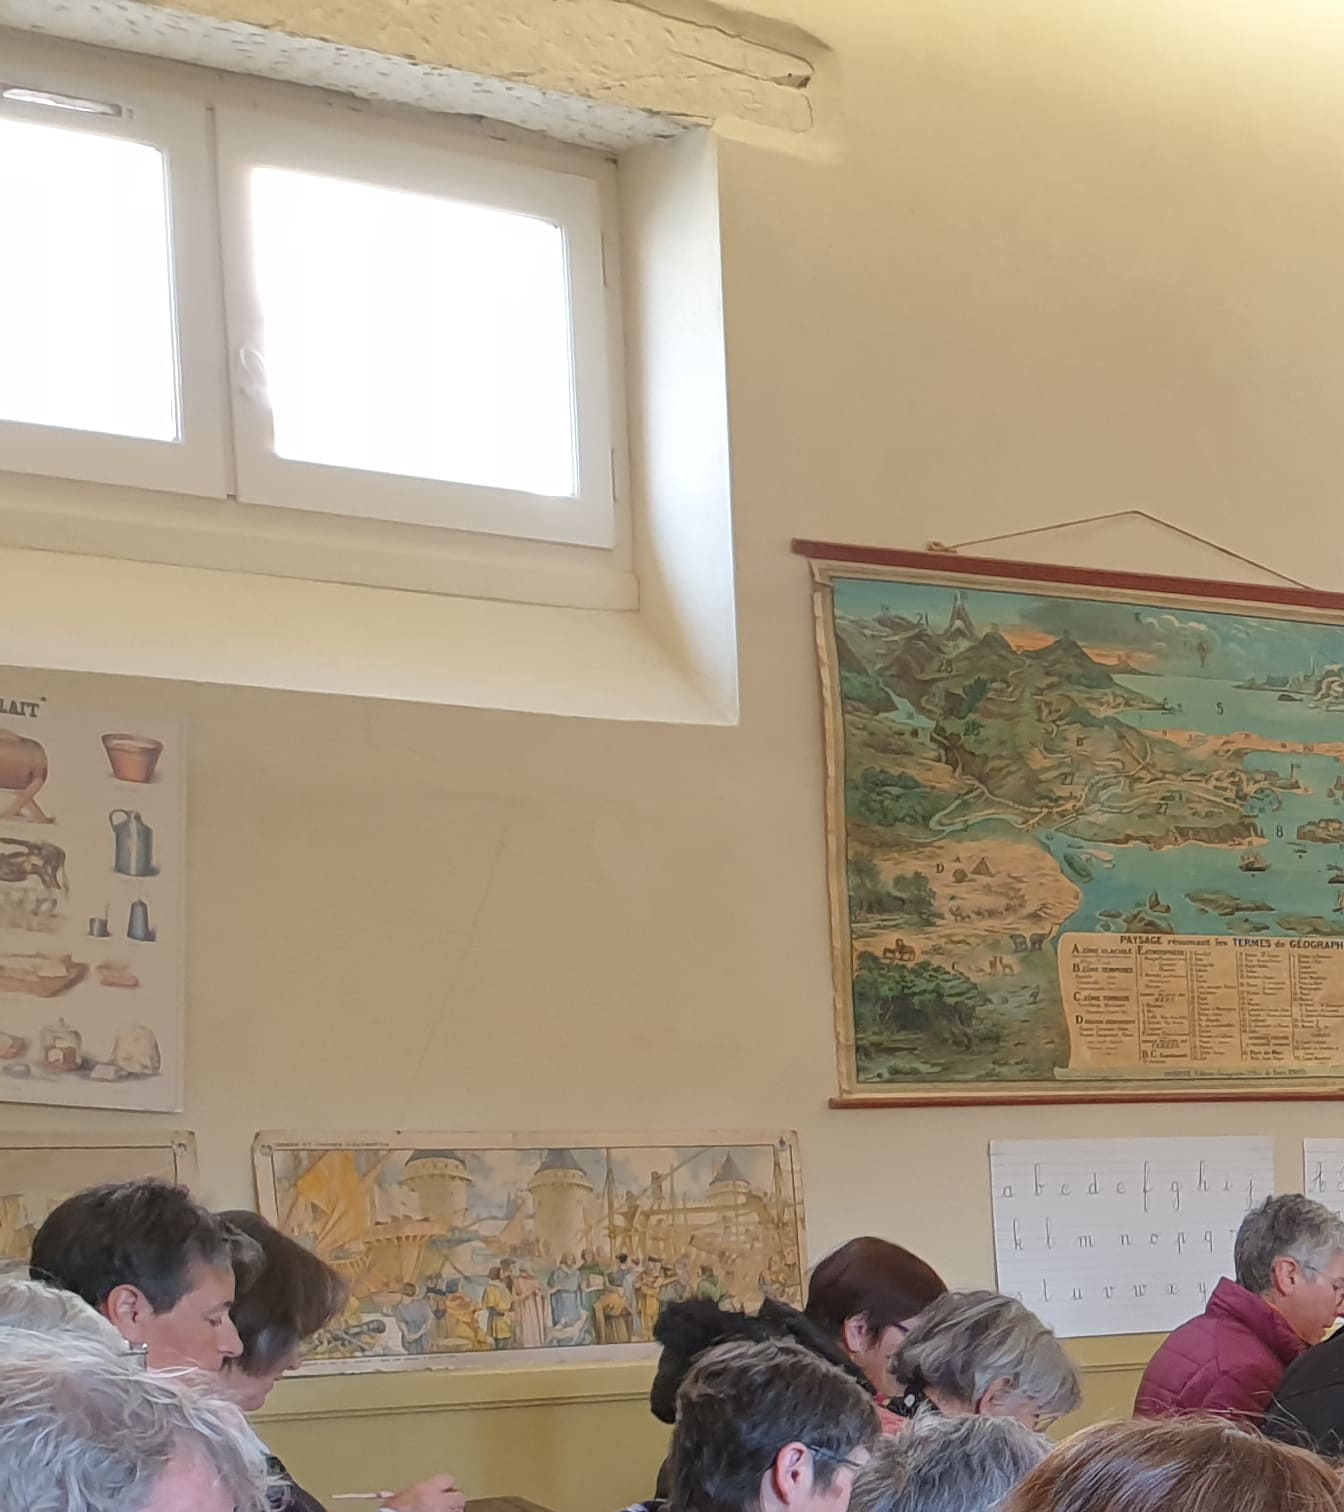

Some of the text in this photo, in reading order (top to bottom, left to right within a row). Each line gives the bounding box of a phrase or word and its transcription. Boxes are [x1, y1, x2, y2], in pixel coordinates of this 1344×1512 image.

[1216, 702, 1224, 716] 5
[1276, 825, 1284, 838] 8
[1120, 935, 1162, 945] PAYSAGE
[1233, 938, 1271, 949] TERMES
